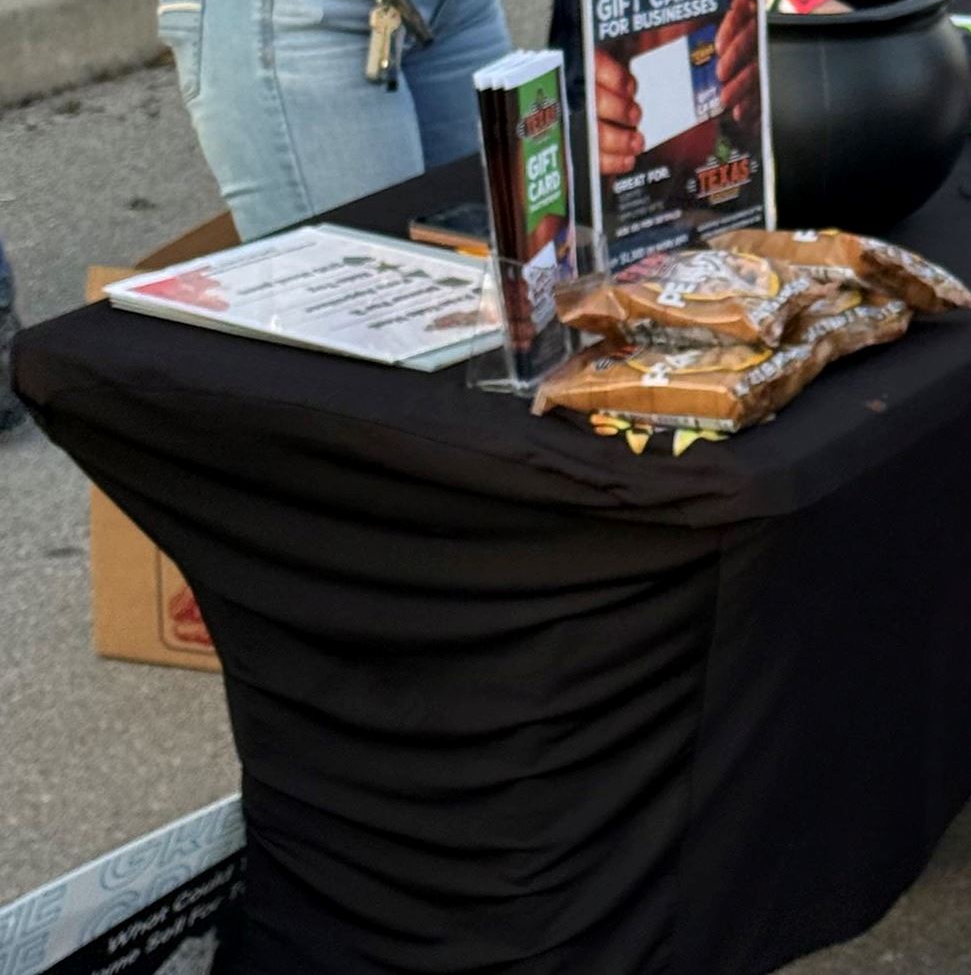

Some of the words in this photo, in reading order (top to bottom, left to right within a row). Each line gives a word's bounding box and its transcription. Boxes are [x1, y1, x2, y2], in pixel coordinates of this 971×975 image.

[598, 19, 631, 41] FOR
[527, 144, 559, 180] GIFT
[697, 158, 751, 194] TEXAS
[528, 170, 561, 203] CARD
